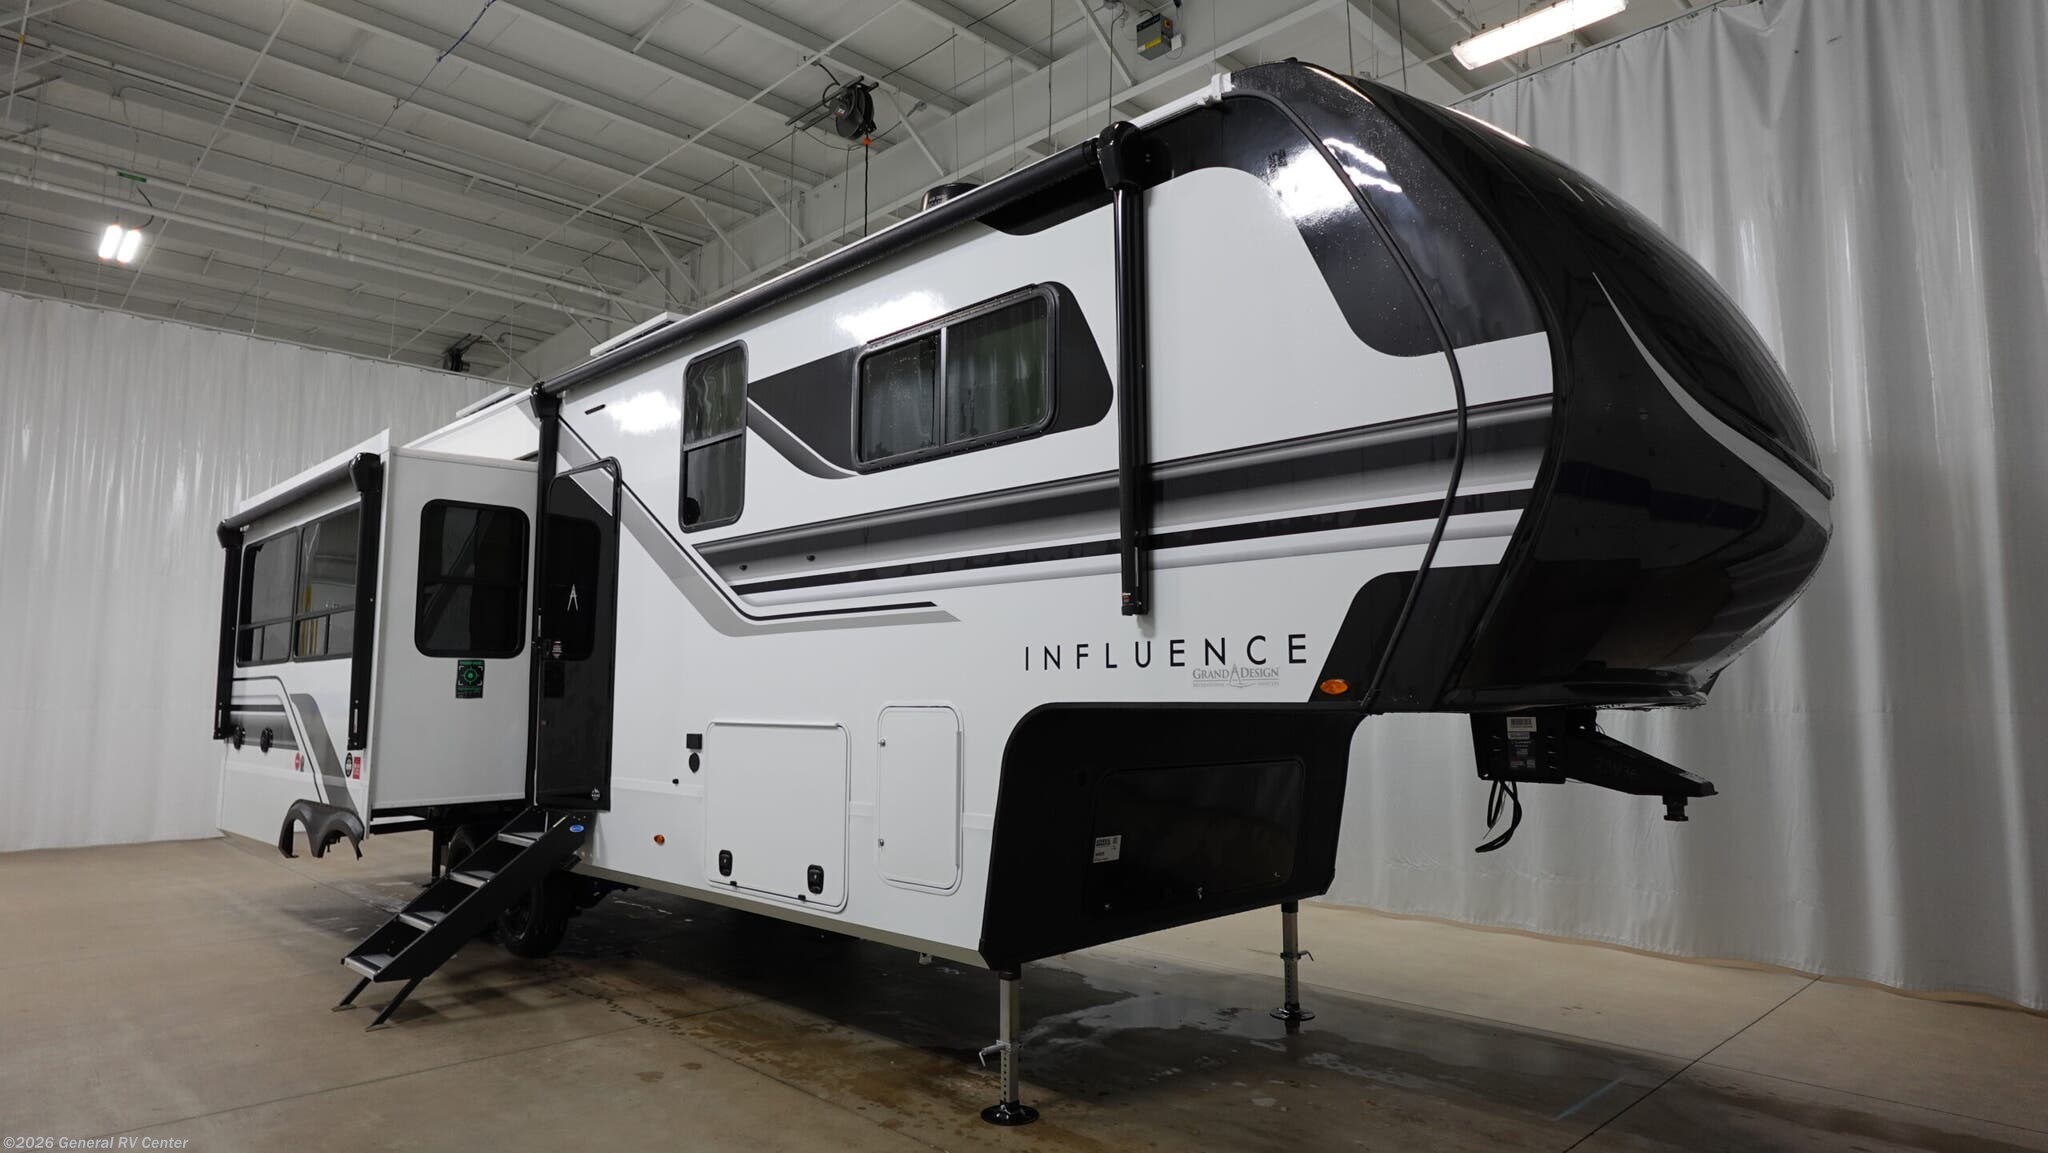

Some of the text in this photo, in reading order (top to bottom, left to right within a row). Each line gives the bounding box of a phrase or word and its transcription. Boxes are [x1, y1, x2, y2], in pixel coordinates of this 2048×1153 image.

[1025, 634, 1307, 671] INFLUENCE
[1192, 667, 1279, 680] GRAND DESIGN
